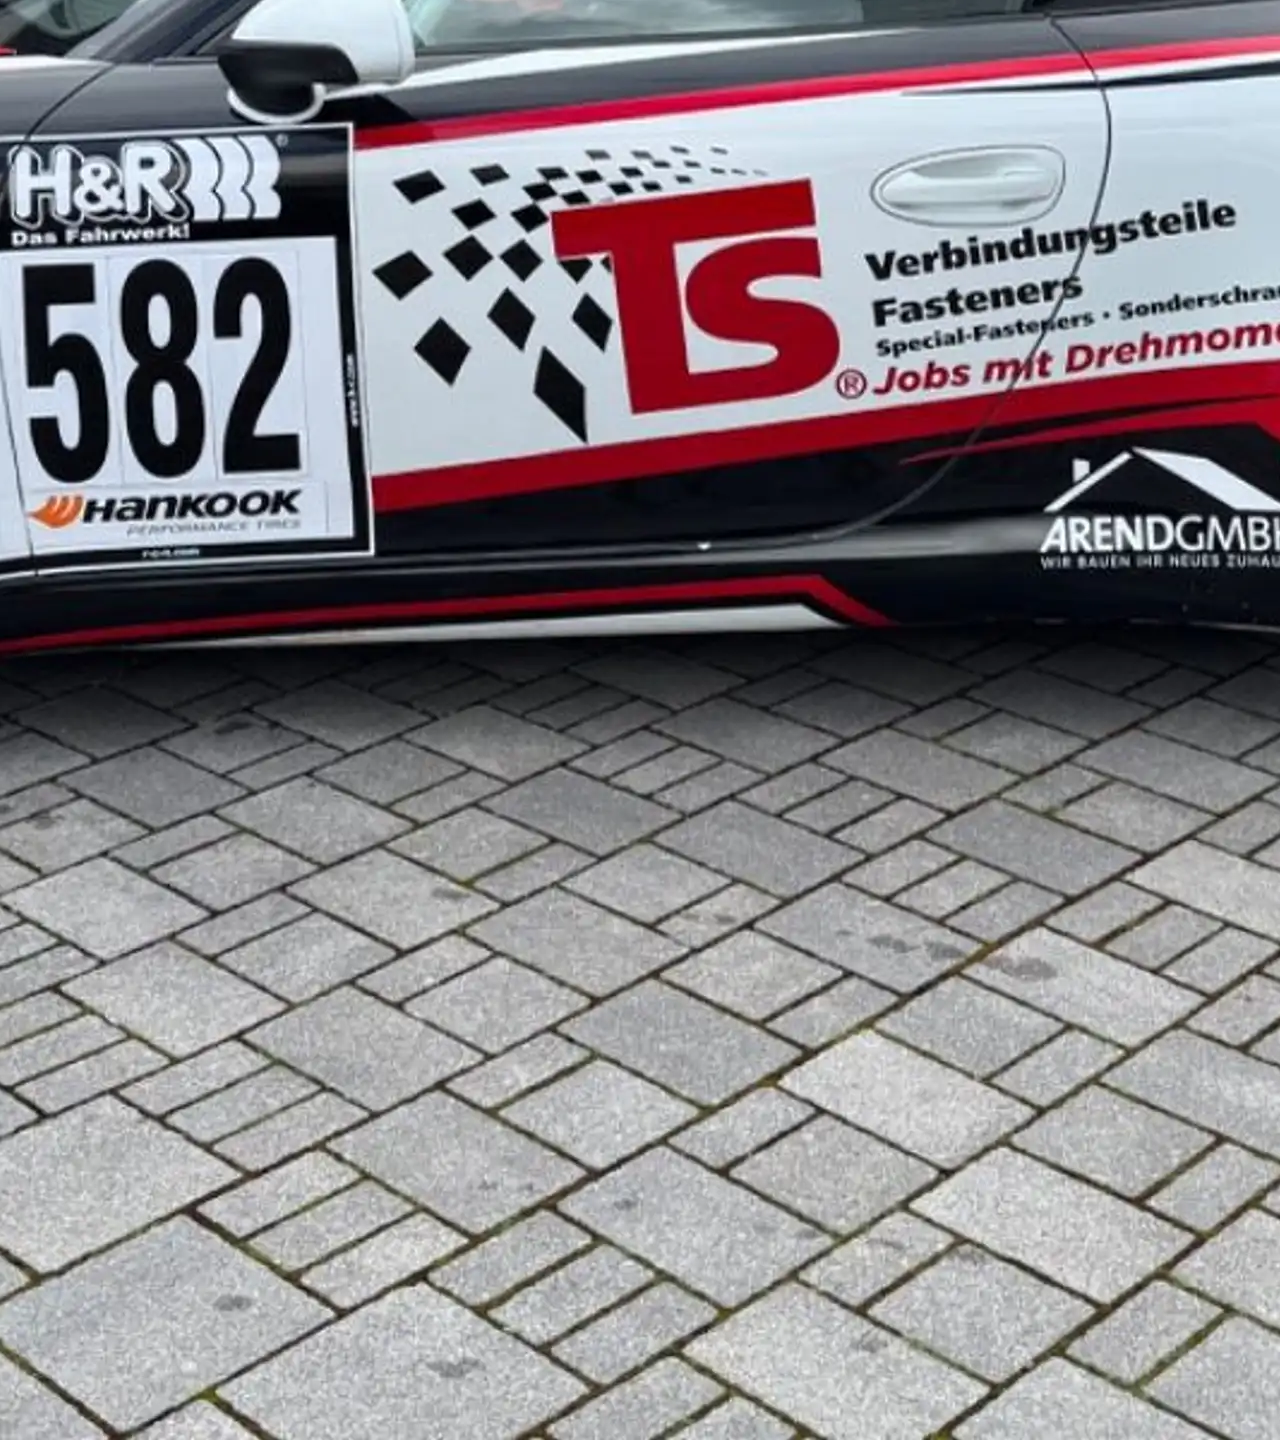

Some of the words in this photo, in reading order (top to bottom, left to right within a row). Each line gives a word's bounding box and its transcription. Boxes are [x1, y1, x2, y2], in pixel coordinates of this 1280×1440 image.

[8, 139, 190, 228] H&R
[11, 229, 58, 247] Das
[65, 222, 191, 244] Fahrwerk!
[865, 199, 1237, 282] Verbindungsteile
[872, 274, 1084, 328] Fasteners
[876, 312, 1095, 358] Special-Fasteners
[20, 256, 302, 483] 582
[872, 361, 971, 396] Jobs
[982, 354, 1053, 383] mit
[126, 519, 248, 537] PERFORMANCE
[1041, 556, 1070, 570] WIR
[1077, 555, 1131, 570] BAUEN
[1170, 553, 1220, 568] NEUES
